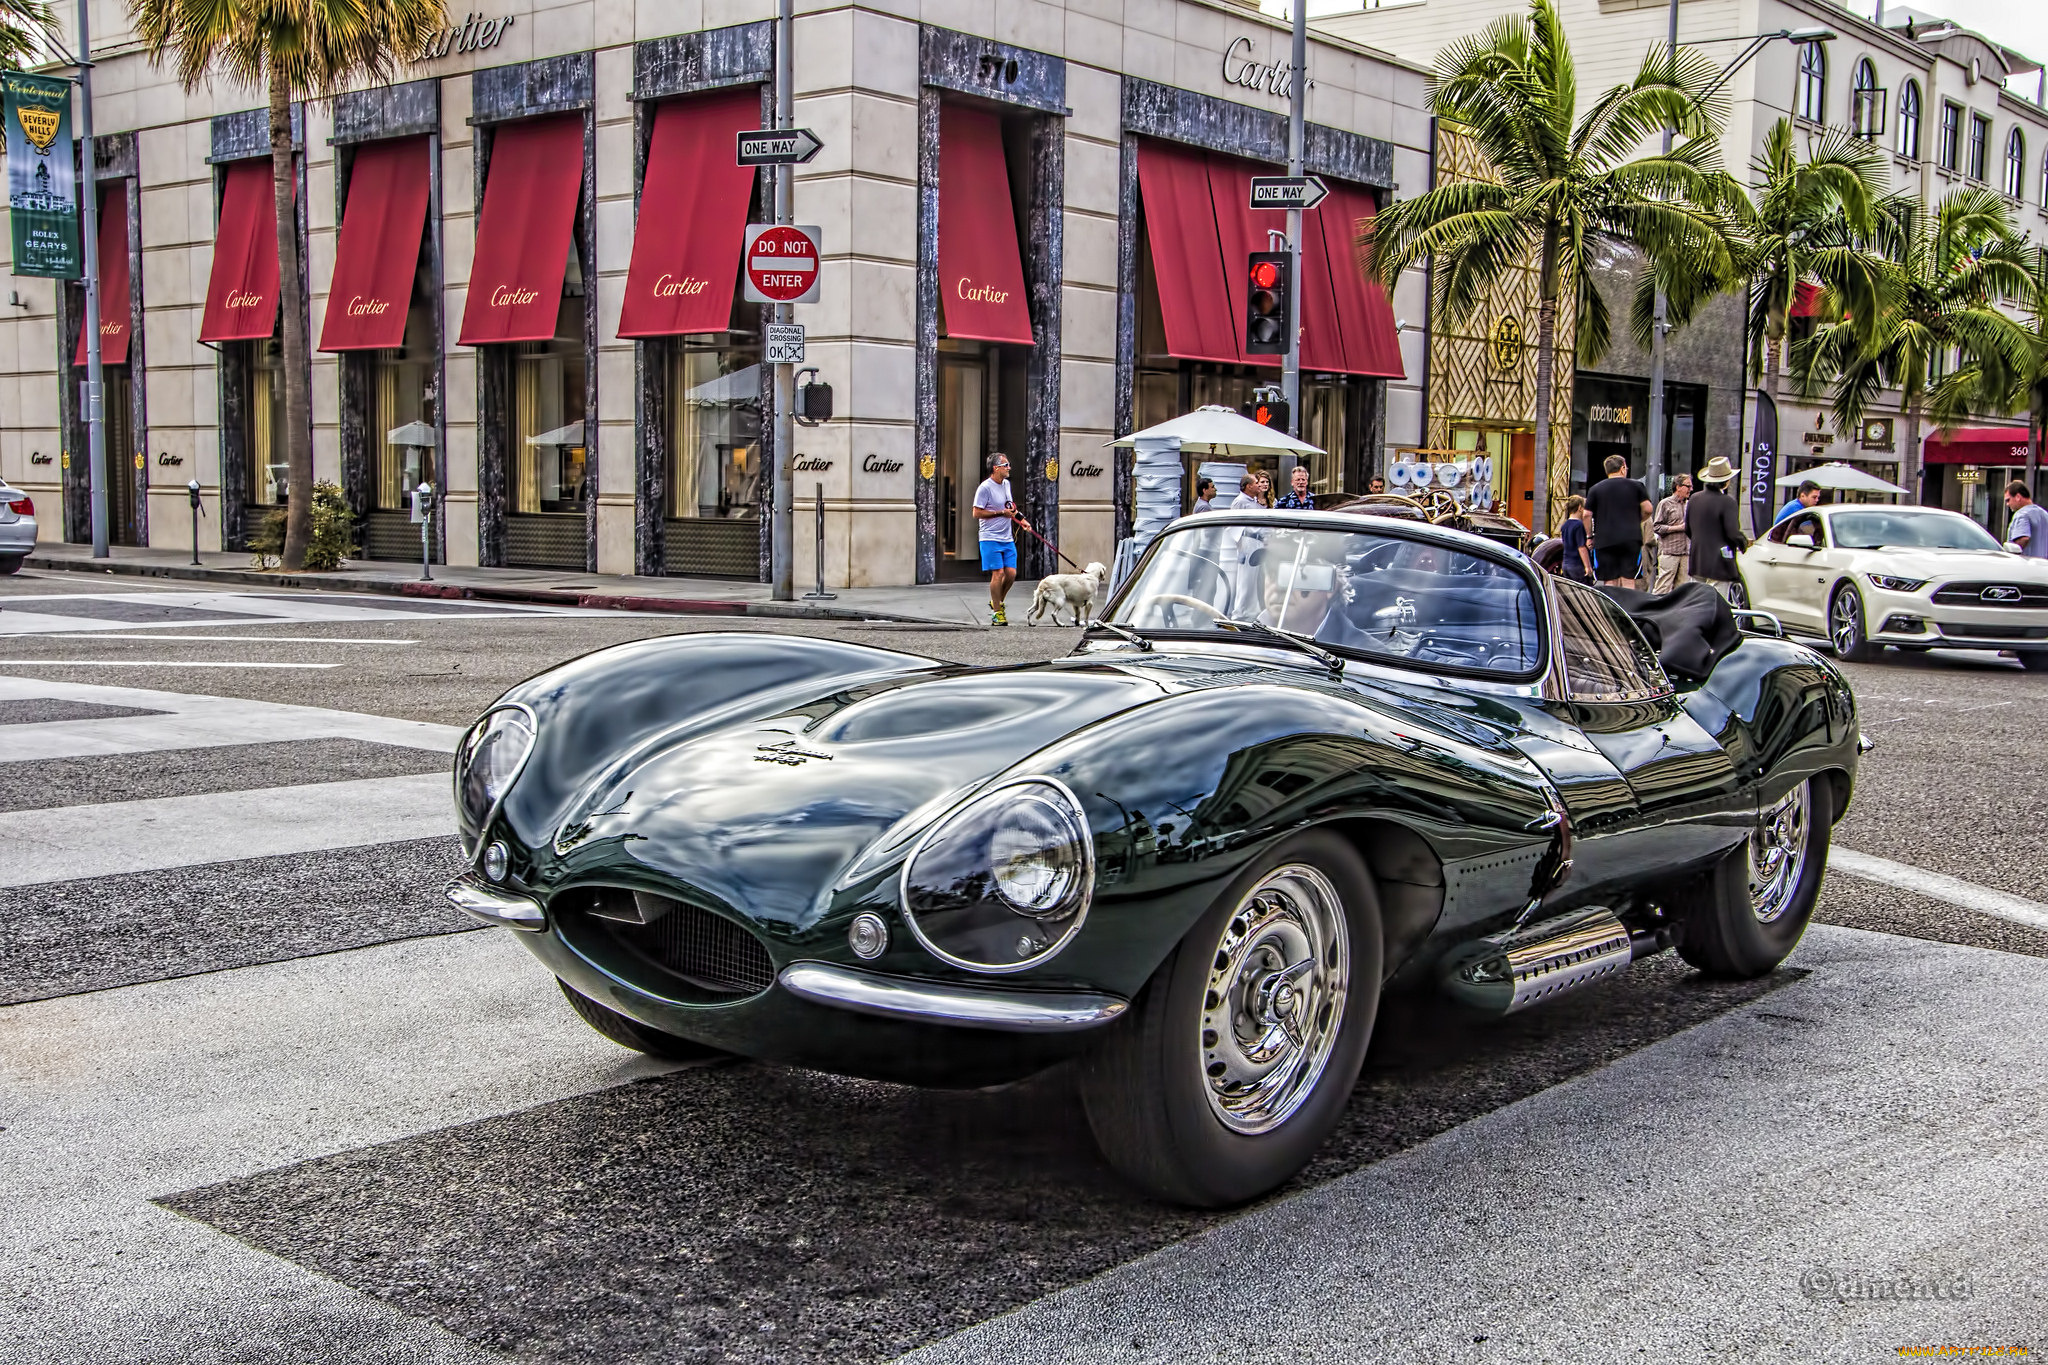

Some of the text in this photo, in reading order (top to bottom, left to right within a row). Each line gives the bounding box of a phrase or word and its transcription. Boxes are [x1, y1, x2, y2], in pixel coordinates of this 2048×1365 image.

[410, 12, 515, 62] artier
[1222, 36, 1315, 99] Cartir
[9, 81, 68, 98] Centennial
[23, 114, 56, 126] BEVERLY
[29, 125, 51, 136] HILLS
[744, 140, 796, 155] ONE WAY
[1257, 186, 1304, 199] ONE WAY
[32, 230, 59, 239] ROLEX
[25, 240, 68, 251] GEARYS
[758, 240, 808, 254] DO NOT
[653, 273, 709, 297] Cartier
[762, 274, 802, 288] ENTER
[491, 285, 539, 307] Cartier
[958, 277, 1009, 304] Cartier
[225, 289, 263, 309] Cartier
[347, 296, 390, 316] Cartier
[769, 327, 802, 335] DIAGONAL
[769, 334, 802, 342] CROSSING
[769, 347, 784, 359] OK
[1590, 404, 1613, 423] roberto
[2010, 446, 2029, 456] 360
[31, 452, 52, 465] Cartier
[159, 452, 183, 466] Cartier
[792, 453, 833, 471] Cartier
[863, 454, 904, 472] Cartier
[1070, 460, 1103, 477] Cartier
